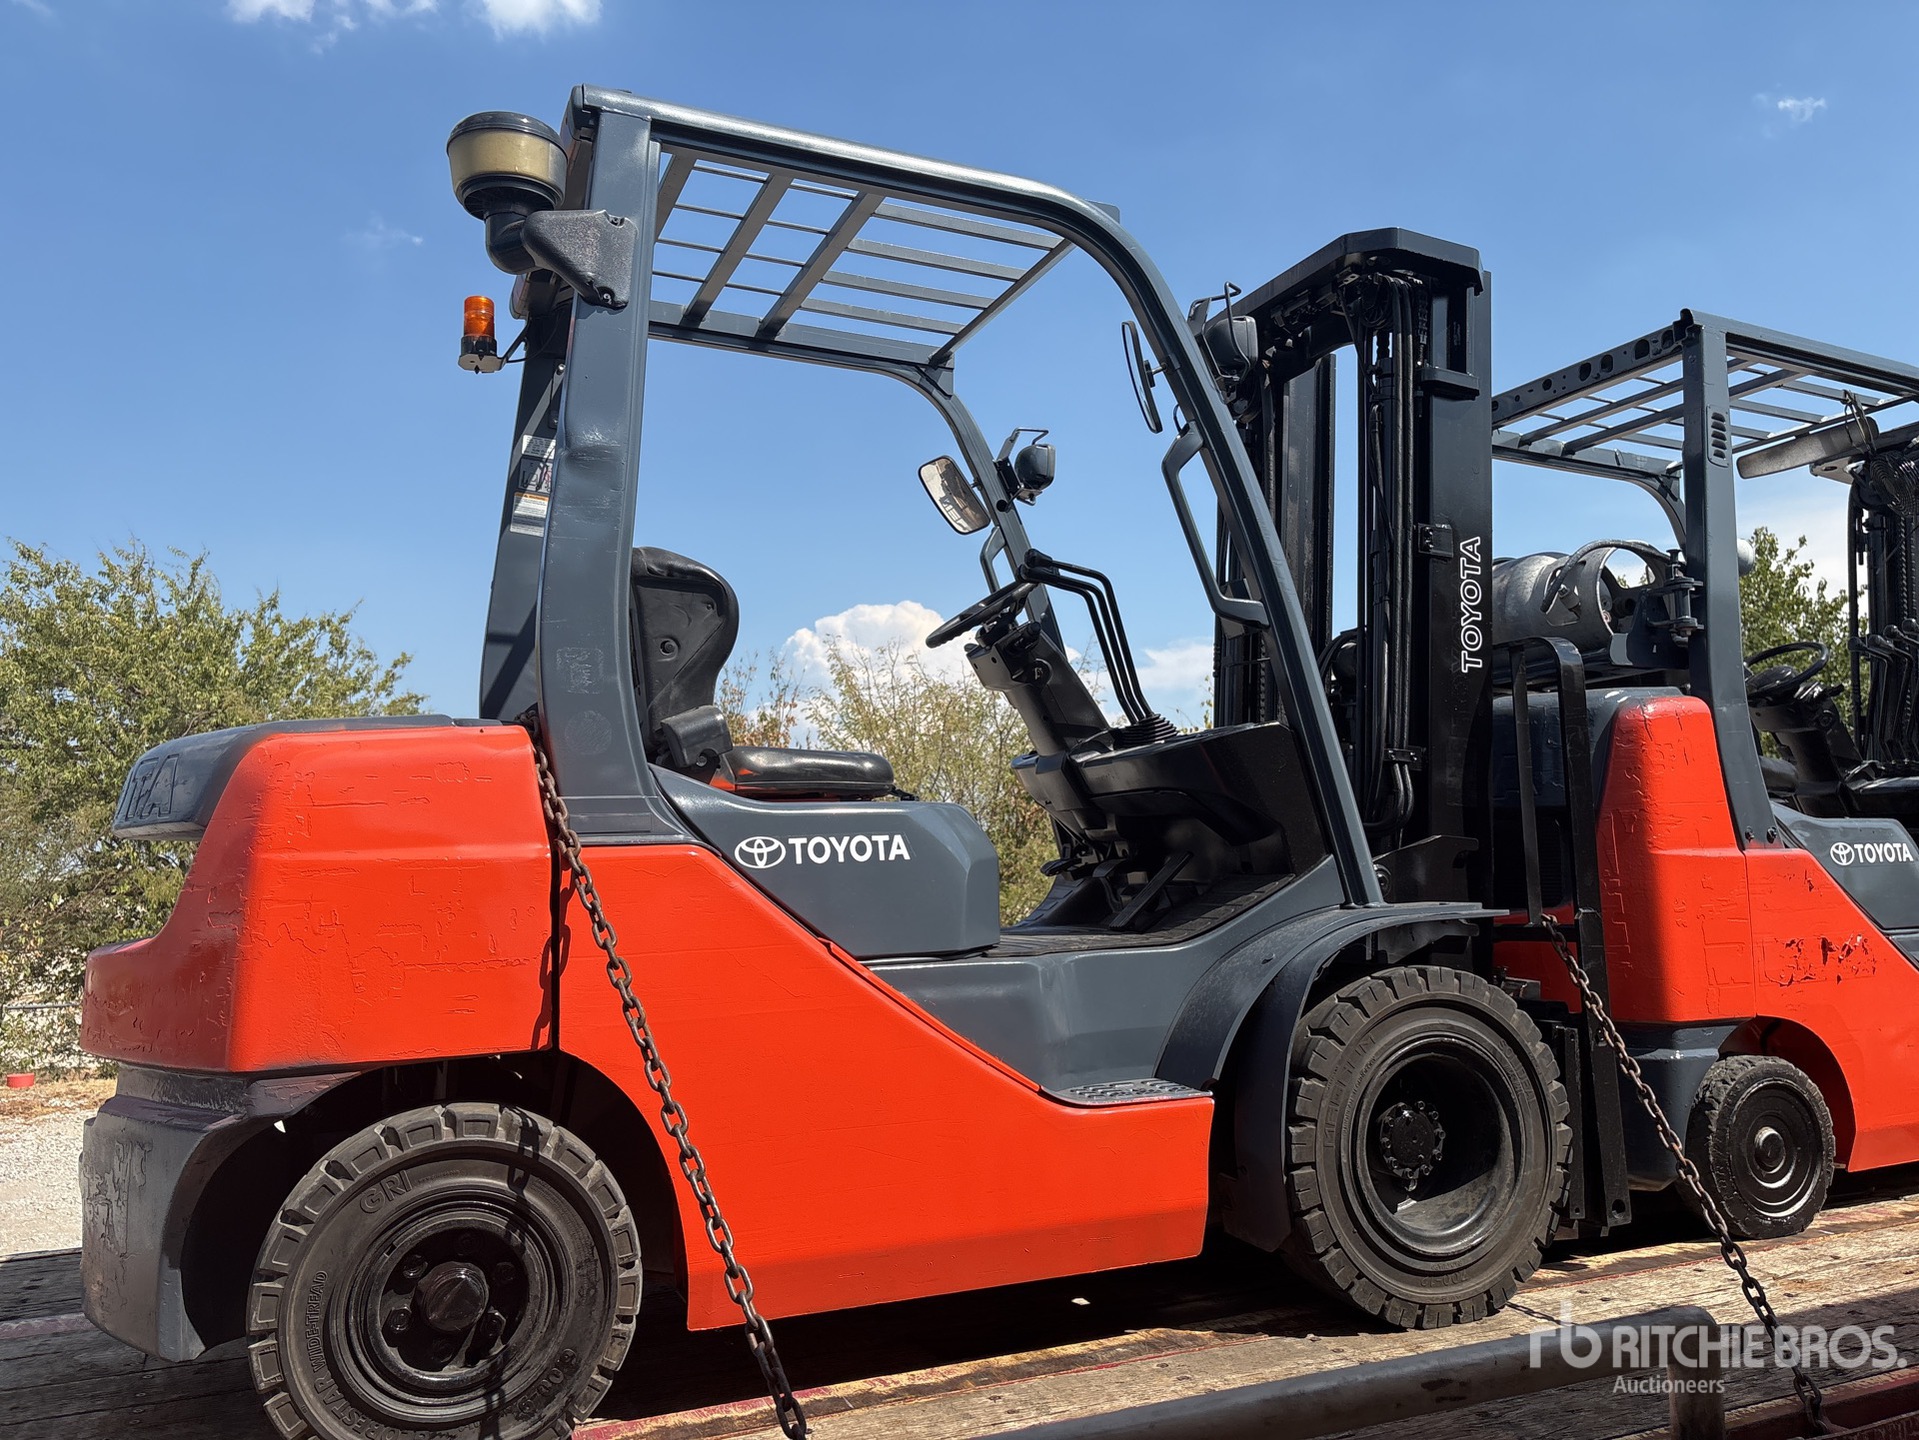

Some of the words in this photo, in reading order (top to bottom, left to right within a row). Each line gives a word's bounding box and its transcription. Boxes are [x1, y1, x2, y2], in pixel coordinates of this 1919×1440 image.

[1460, 536, 1483, 673] TOYOTA
[788, 834, 911, 865] TOYOTA
[1853, 842, 1914, 864] TOYOTA
[360, 1169, 413, 1214] GRI
[305, 1269, 328, 1374] WIDE-TREAD
